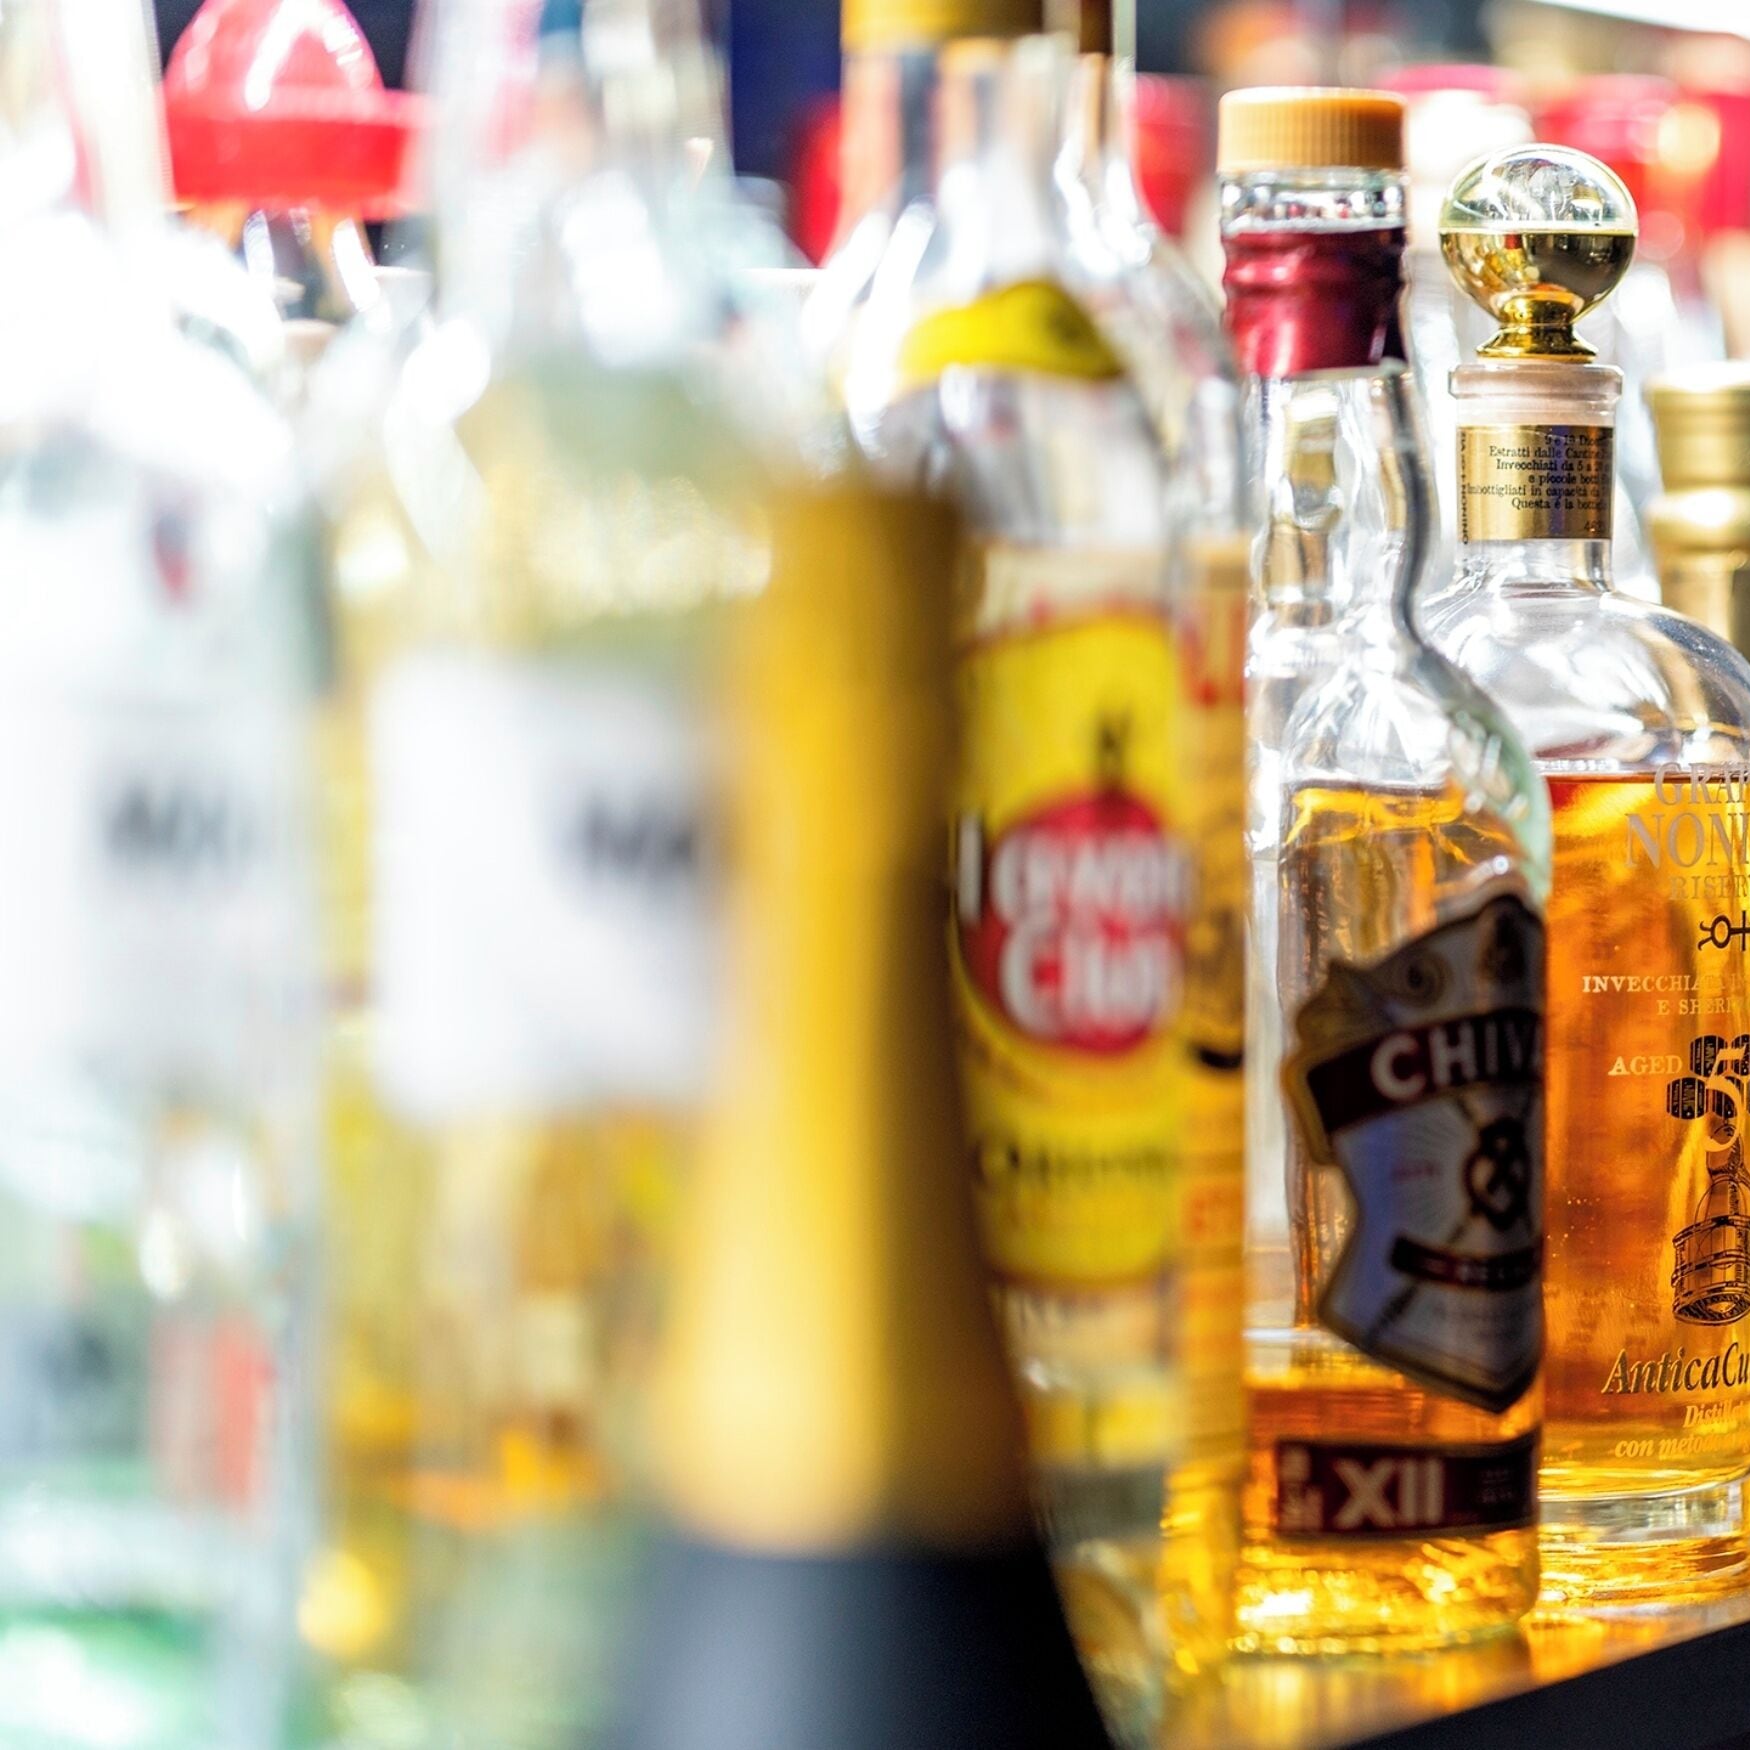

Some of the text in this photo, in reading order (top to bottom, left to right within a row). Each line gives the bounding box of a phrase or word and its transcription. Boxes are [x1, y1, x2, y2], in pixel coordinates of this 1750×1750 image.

[1489, 446, 1530, 458] Estratti
[1534, 446, 1562, 458] dalle
[1496, 458, 1559, 471] Invecchiati
[1528, 474, 1536, 484] e
[1538, 473, 1577, 486] piccole
[1530, 485, 1542, 496] in
[1511, 498, 1551, 510] Questa
[1565, 499, 1574, 510] la
[1658, 1000, 1670, 1016] E
[1607, 1055, 1683, 1076] AGED
[1615, 1438, 1655, 1457] con
[1331, 1456, 1444, 1528] XII
